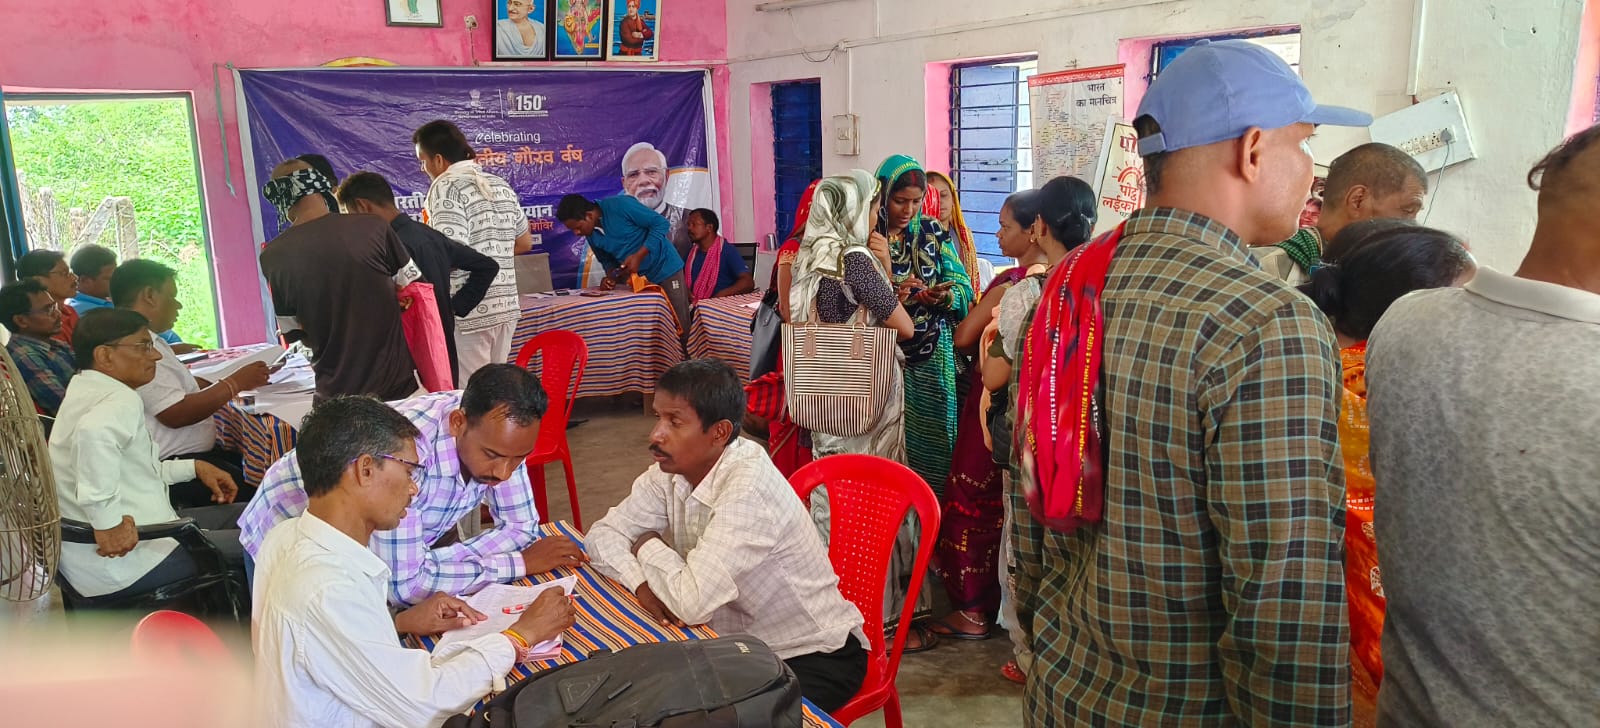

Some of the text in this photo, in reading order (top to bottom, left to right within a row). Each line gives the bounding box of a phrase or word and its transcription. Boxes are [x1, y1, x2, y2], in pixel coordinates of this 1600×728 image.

[1087, 82, 1105, 92] भारत
[1076, 93, 1117, 107] का मानचित्र
[475, 131, 541, 144] Celebrating
[513, 146, 554, 165] गौरव
